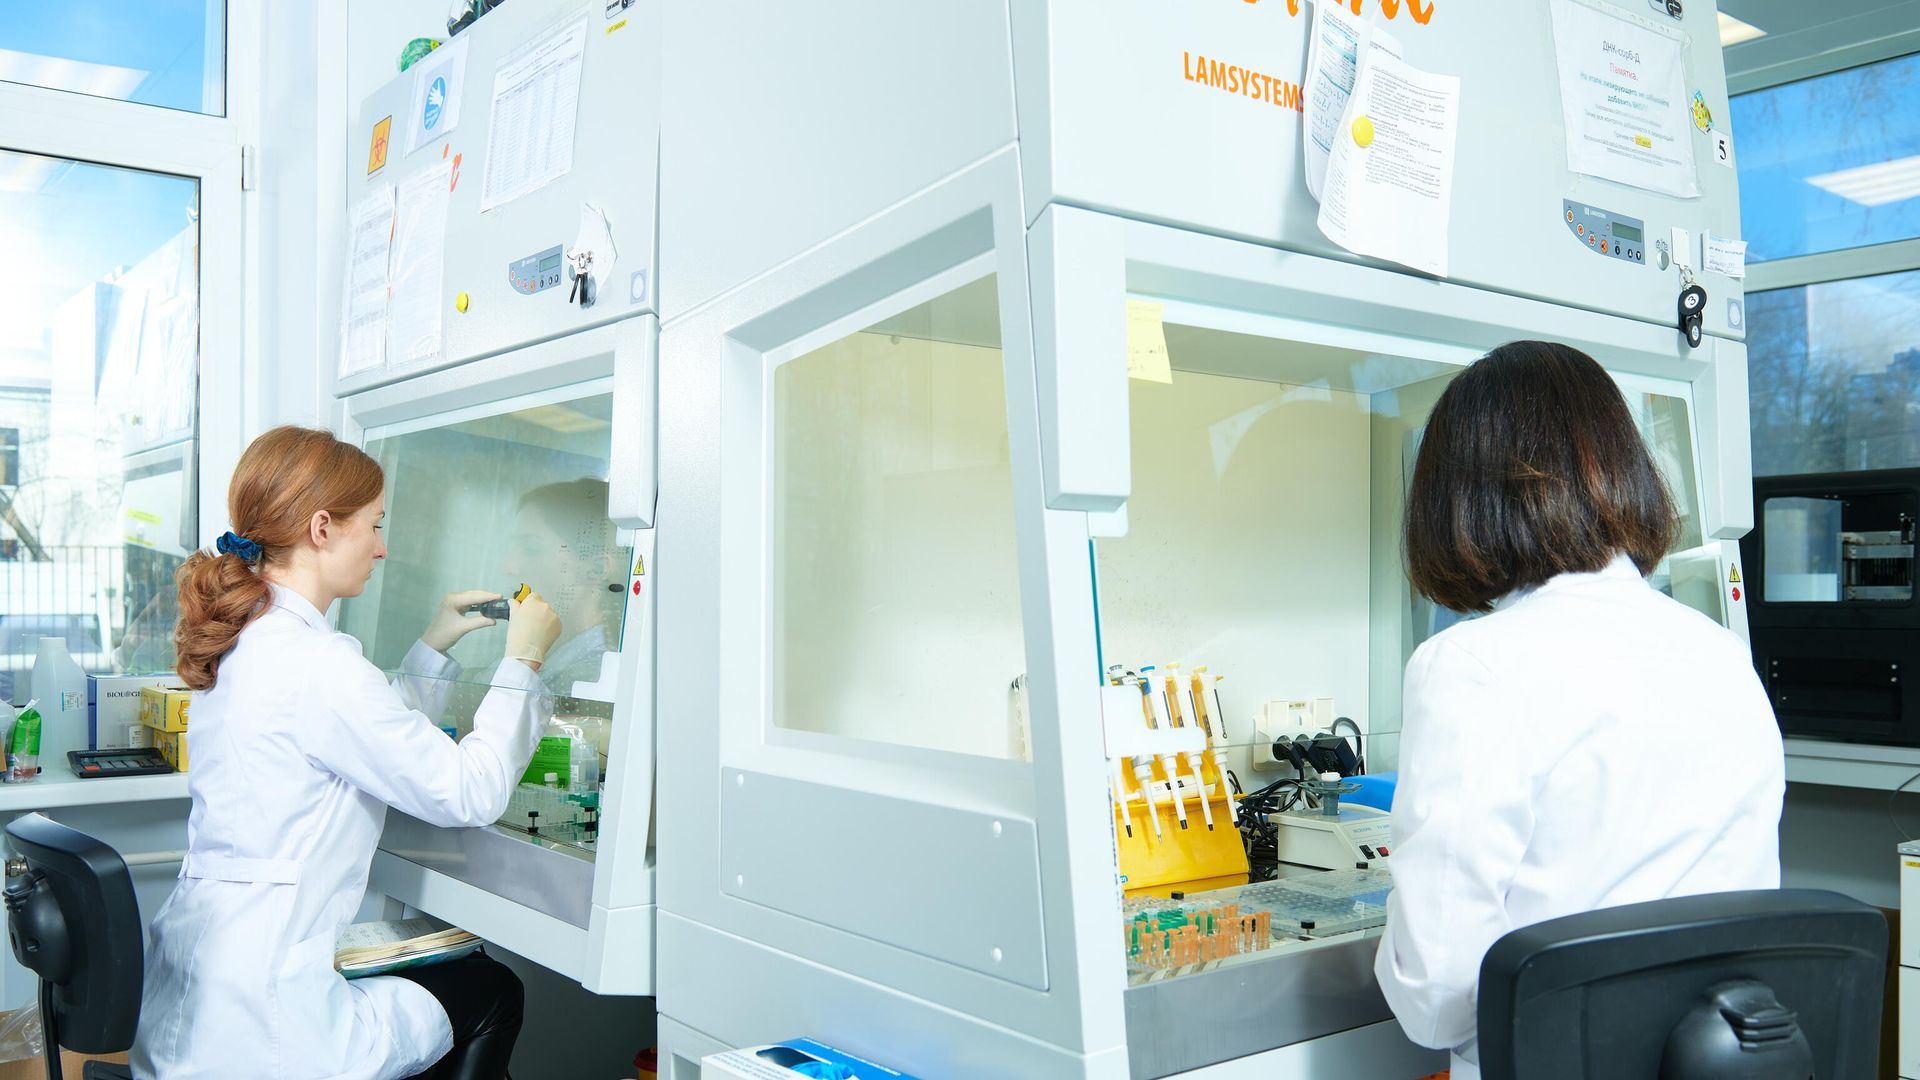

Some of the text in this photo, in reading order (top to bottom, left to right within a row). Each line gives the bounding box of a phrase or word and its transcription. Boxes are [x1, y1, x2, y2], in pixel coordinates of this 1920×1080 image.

[1602, 40, 1640, 64] ДНК-сорб-Д
[1609, 63, 1639, 80] Памятка.
[1719, 139, 1727, 160] 5
[1688, 295, 1696, 306] 3
